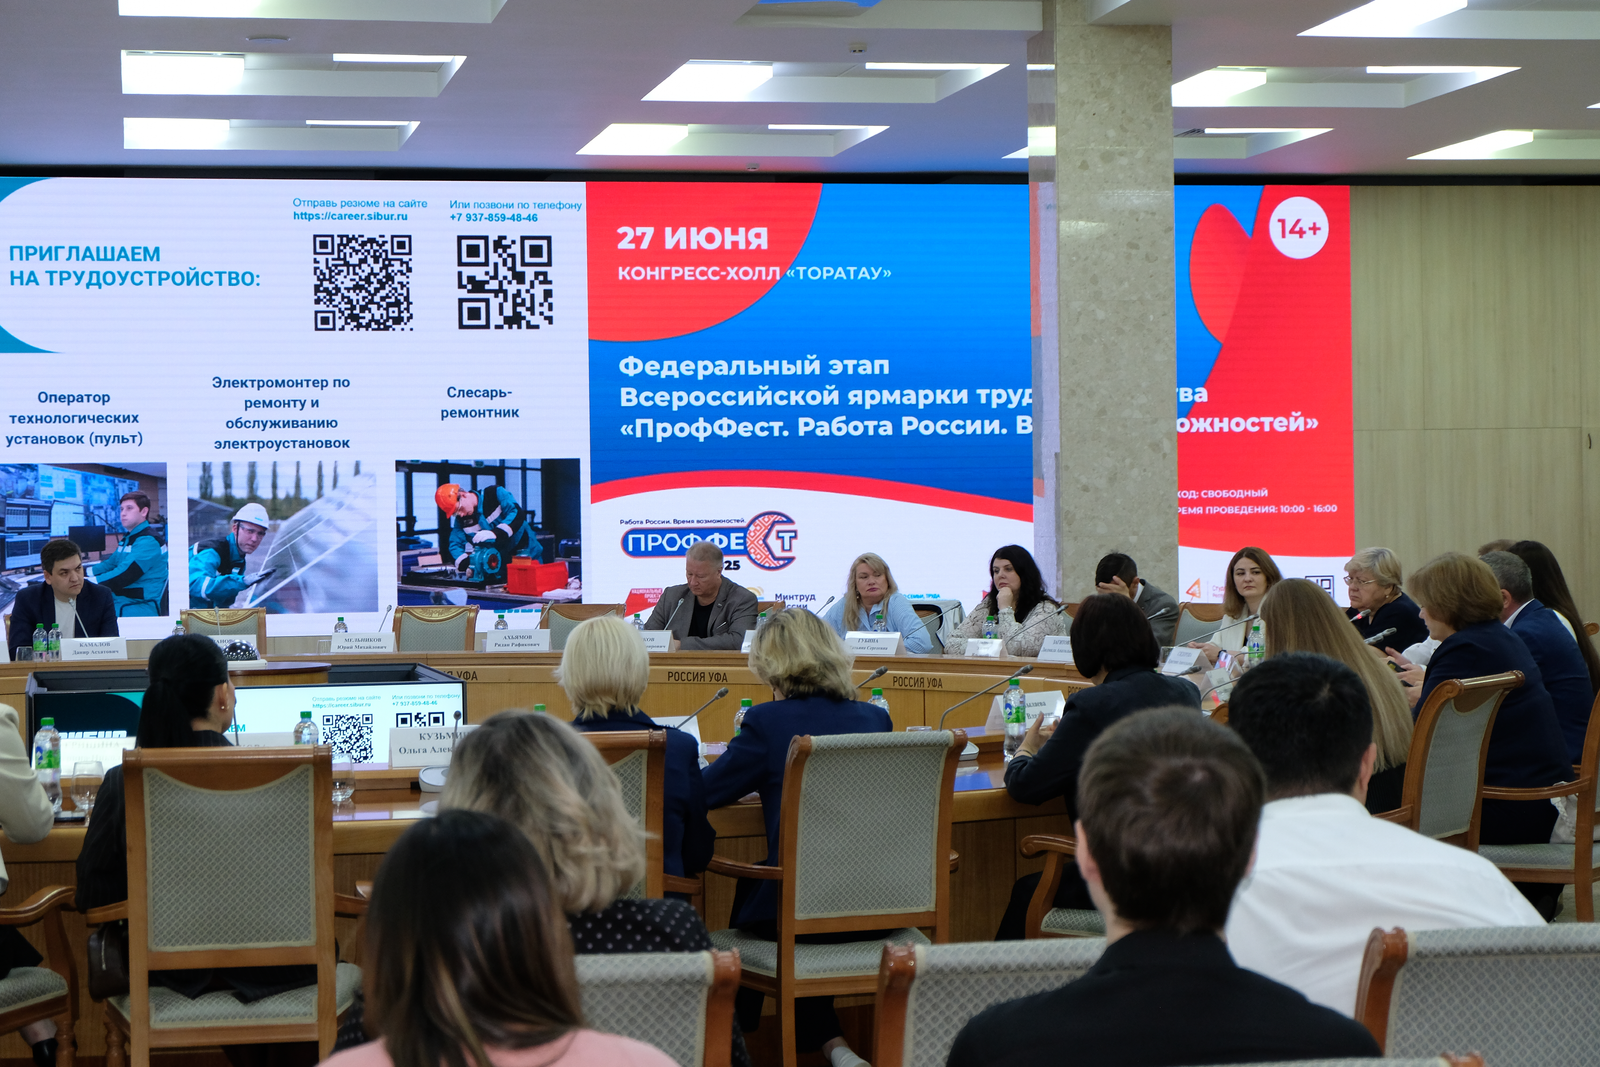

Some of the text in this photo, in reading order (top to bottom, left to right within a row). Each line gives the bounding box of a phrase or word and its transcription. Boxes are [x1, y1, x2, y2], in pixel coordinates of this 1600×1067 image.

[293, 198, 337, 209] Отправь
[340, 201, 380, 209] резюме
[398, 199, 428, 208] сайте
[449, 200, 471, 209] Или
[532, 200, 583, 211] телефону
[293, 211, 408, 222] https://career.sibur.ru
[449, 212, 538, 222] +7 937-859-48-46
[1277, 218, 1322, 239] 14+
[617, 226, 768, 250] 27 ИЮНЯ
[9, 245, 161, 262] ПРИГЛАШАЕМ
[9, 267, 261, 289] НА ТРУДОУСТРОЙСТВО:
[618, 266, 892, 281] КОНГРЕСС-ХОЛЛ «ТОРАТАУ»
[618, 355, 890, 380] Федеральный этап
[212, 375, 351, 391] Электромонтер по
[37, 391, 111, 407] Оператор
[446, 386, 513, 401] Слесарь-
[620, 385, 840, 412] Всероссийской
[847, 389, 969, 409] ярмарки
[1177, 387, 1209, 403] ва
[244, 399, 320, 412] ремонту и
[8, 412, 140, 425] технологических
[440, 408, 520, 422] ремонтник
[225, 416, 338, 431] обслуживанию
[620, 417, 790, 443] «ПрофФест.
[798, 415, 893, 436] Работа
[901, 416, 1008, 436] России.
[1177, 411, 1319, 434] ожностей»
[5, 431, 143, 449] установок (пульт)
[214, 438, 351, 452] электроустановок
[1201, 488, 1268, 499] СВОБОДНЫЙ
[1205, 505, 1278, 515] ПРОВЕДЕНИЯ:
[1280, 505, 1304, 513] 10:00
[1313, 504, 1337, 513] 16:00
[775, 593, 816, 602] Минтруд
[456, 670, 478, 681] УФА
[667, 671, 728, 683] РОССИЯ УФА
[892, 676, 943, 689] РОССИЯ УФА
[399, 746, 428, 754] Ольга
